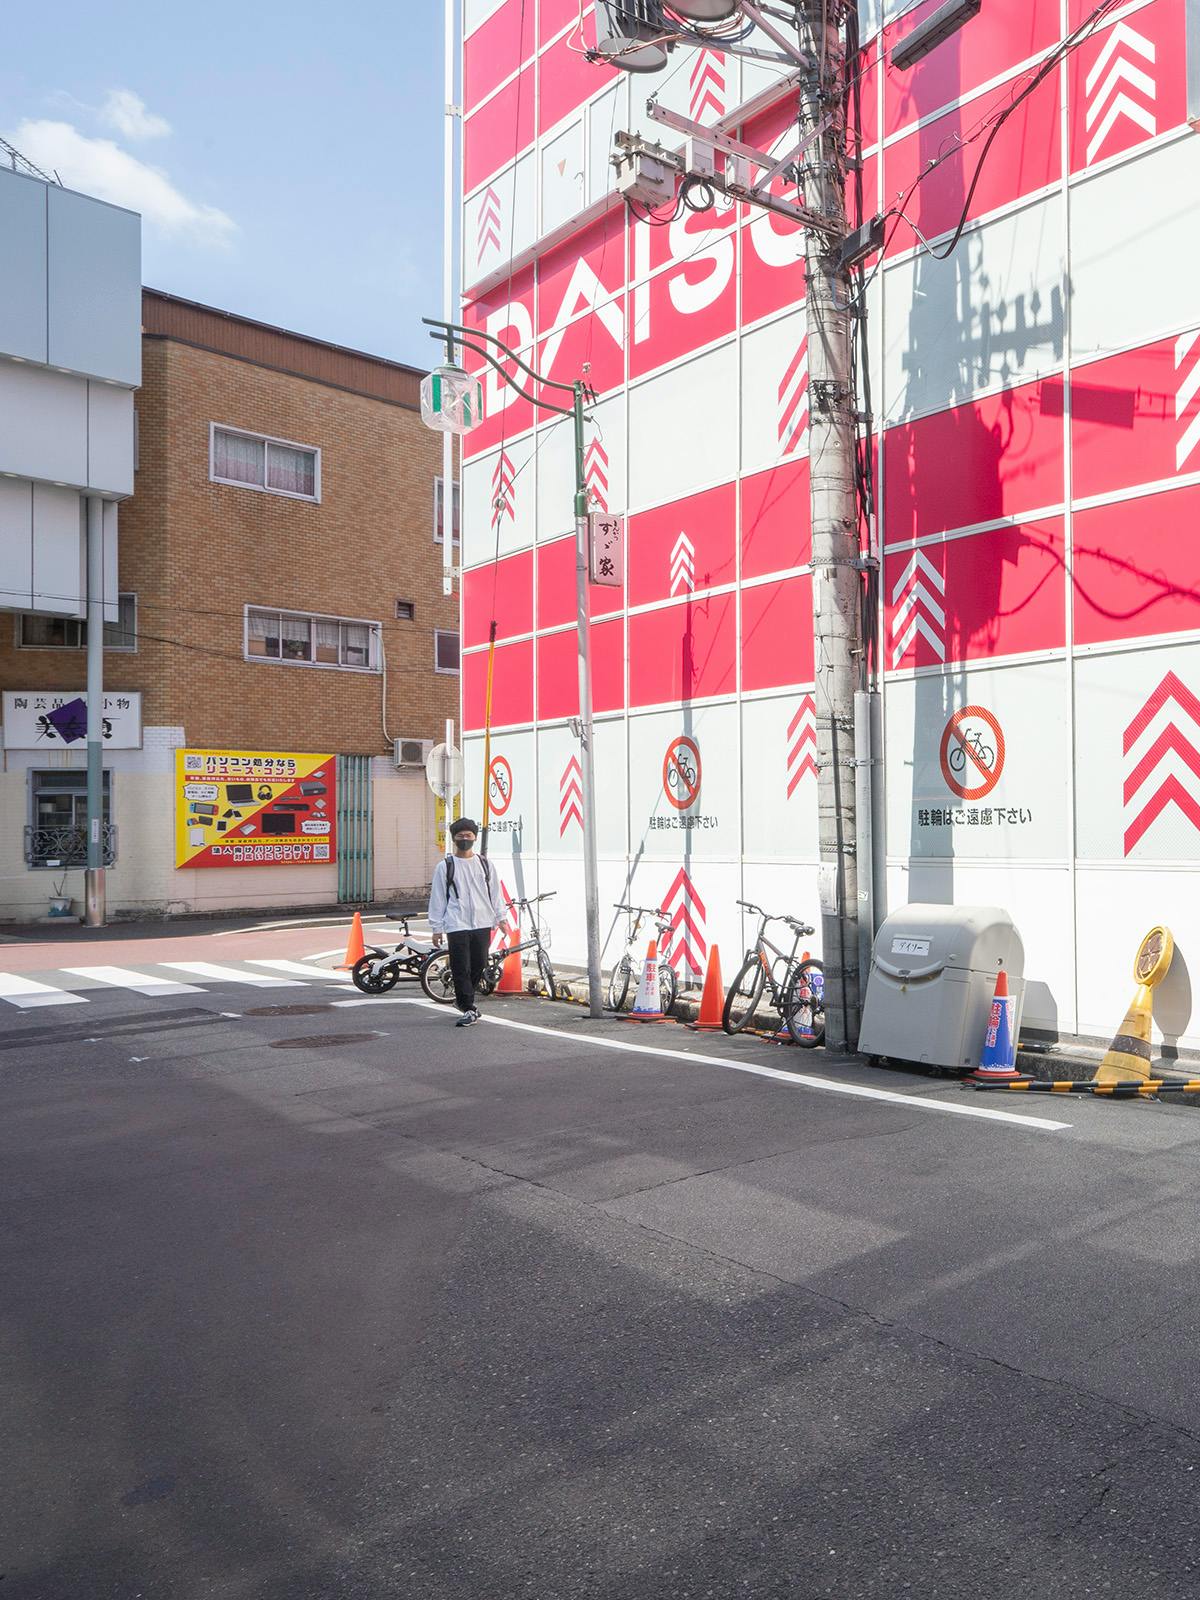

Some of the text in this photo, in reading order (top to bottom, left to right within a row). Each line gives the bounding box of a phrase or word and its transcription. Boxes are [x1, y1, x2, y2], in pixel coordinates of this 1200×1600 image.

[206, 757, 295, 767] パソコン処分なら
[649, 816, 719, 829] 駐輪はご遠慮下さい
[918, 808, 1032, 826] 駐輪はご遠慮下さい
[212, 845, 310, 855] 法人向けパソコン処分
